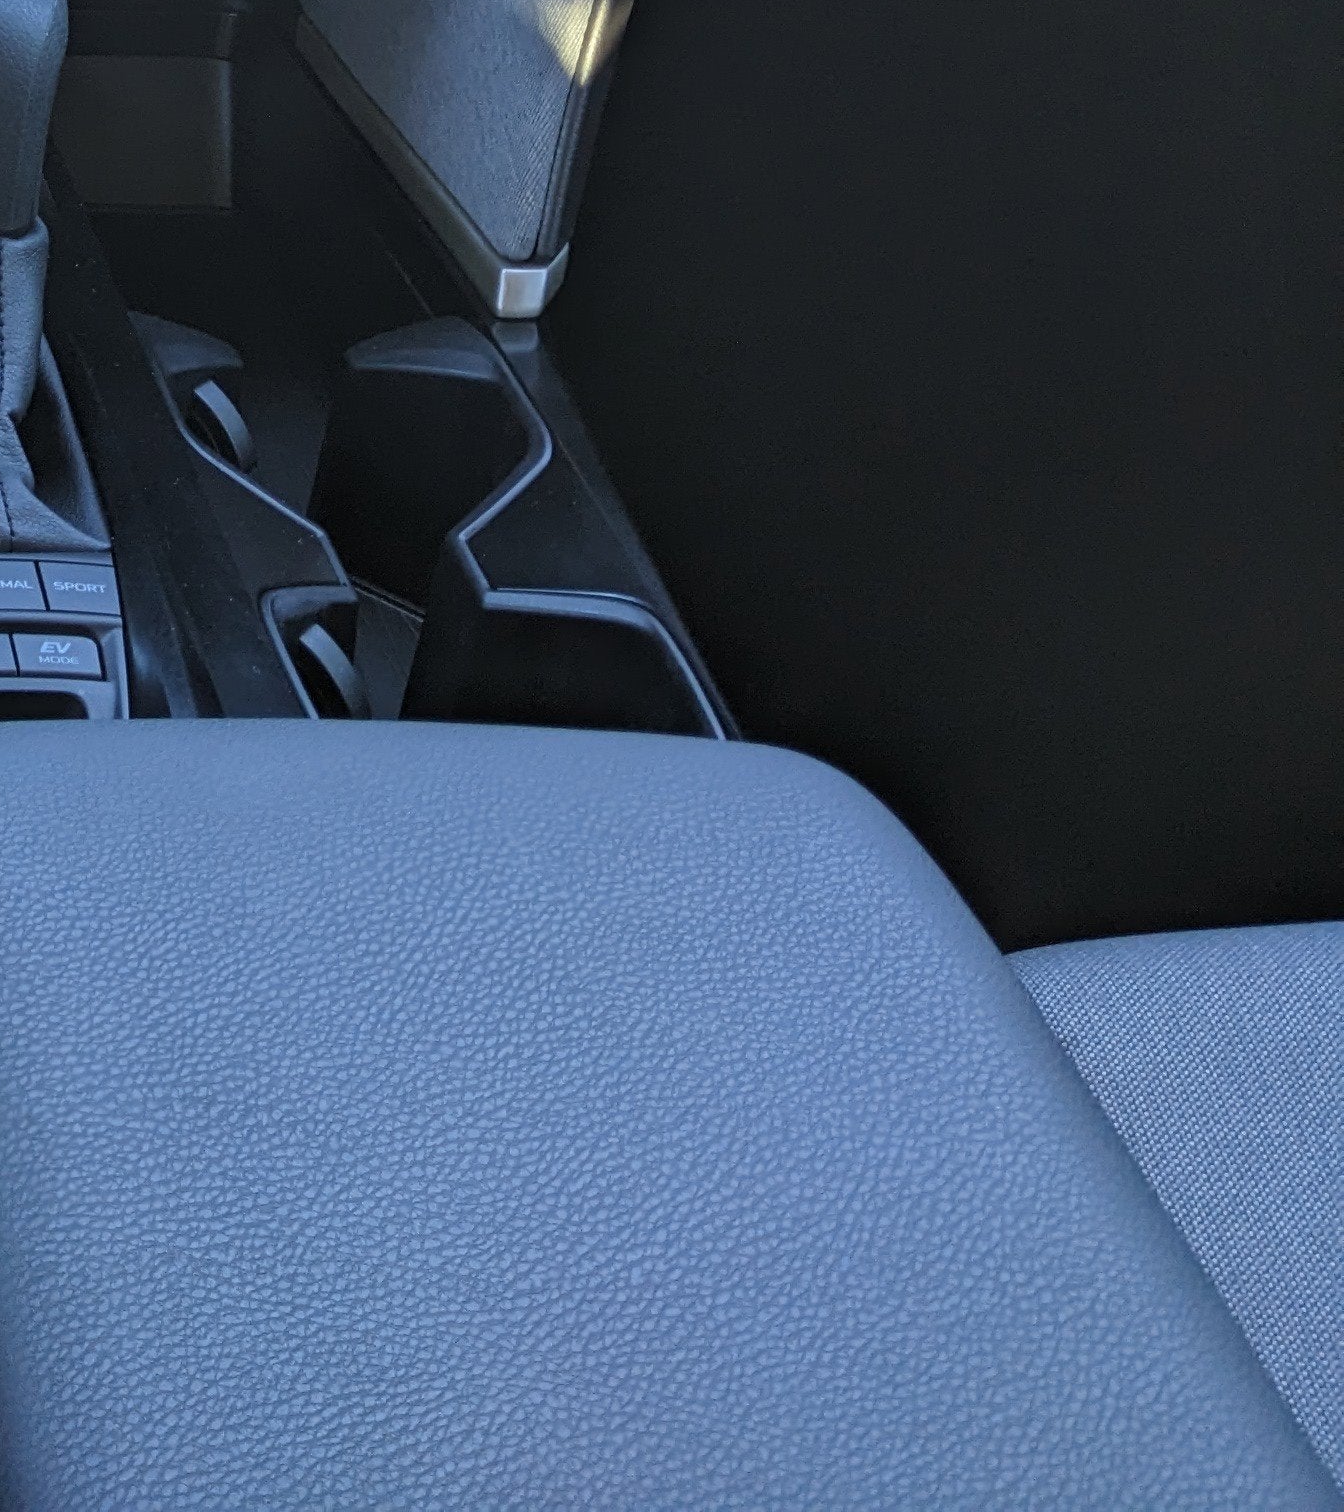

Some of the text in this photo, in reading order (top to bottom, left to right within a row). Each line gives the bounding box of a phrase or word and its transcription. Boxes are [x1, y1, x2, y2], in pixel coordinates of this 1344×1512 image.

[53, 581, 106, 594] SPORT
[40, 641, 73, 654] EV
[38, 655, 80, 665] MODE
